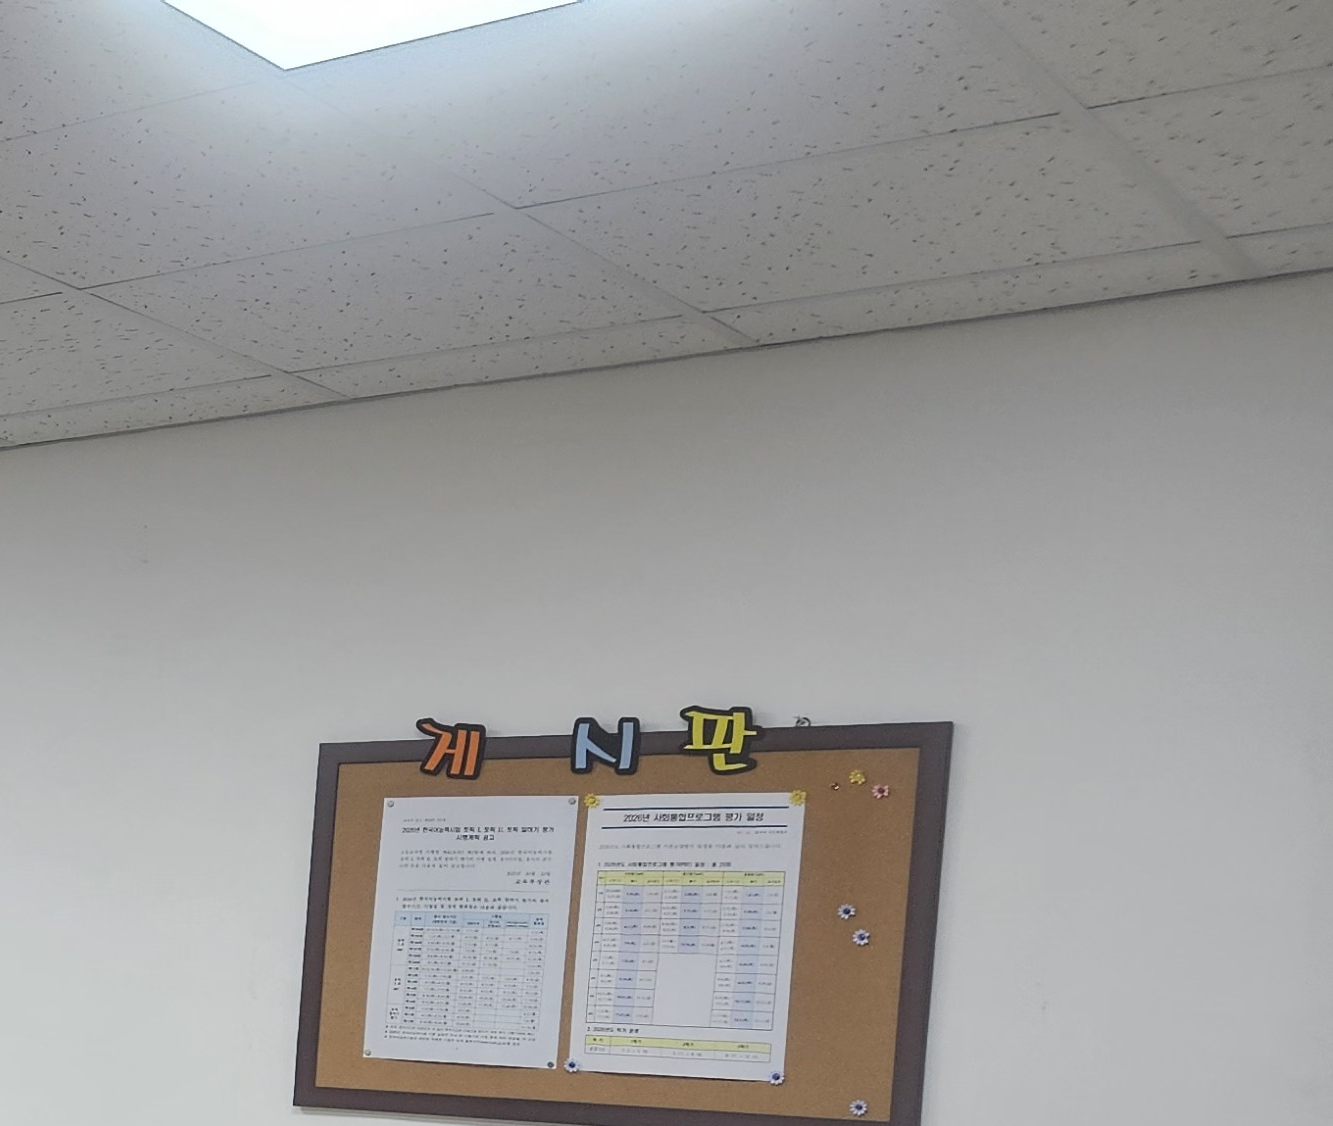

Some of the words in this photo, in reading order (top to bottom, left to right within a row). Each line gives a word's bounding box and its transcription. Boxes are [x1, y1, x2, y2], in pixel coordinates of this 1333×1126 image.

[623, 813, 650, 822] 2026년
[725, 812, 743, 822] 평가
[746, 812, 765, 822] 일정
